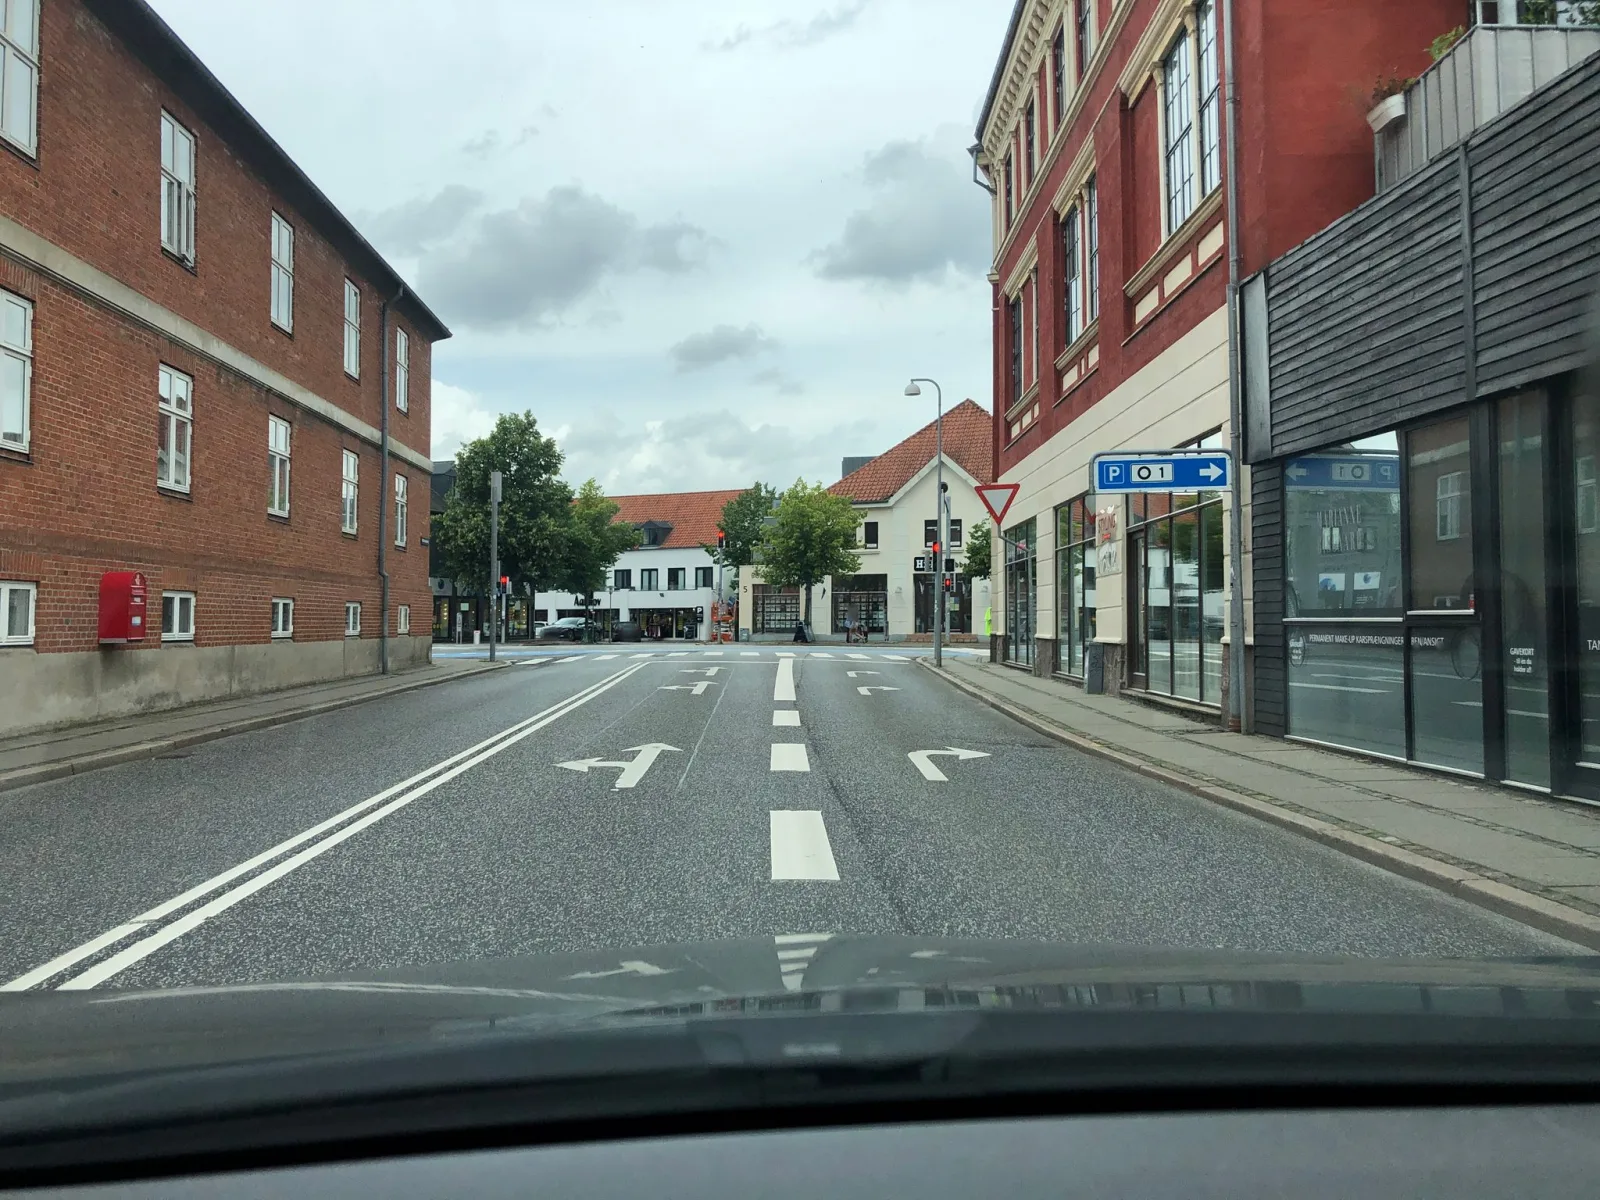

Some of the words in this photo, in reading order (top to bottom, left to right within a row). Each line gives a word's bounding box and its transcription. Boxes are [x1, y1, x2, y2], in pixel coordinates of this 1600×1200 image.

[1109, 466, 1120, 481] P
[1309, 634, 1334, 643] PERMANENT
[1335, 634, 1355, 644] MAKE-UP
[1509, 647, 1535, 656] GAVEKORT
